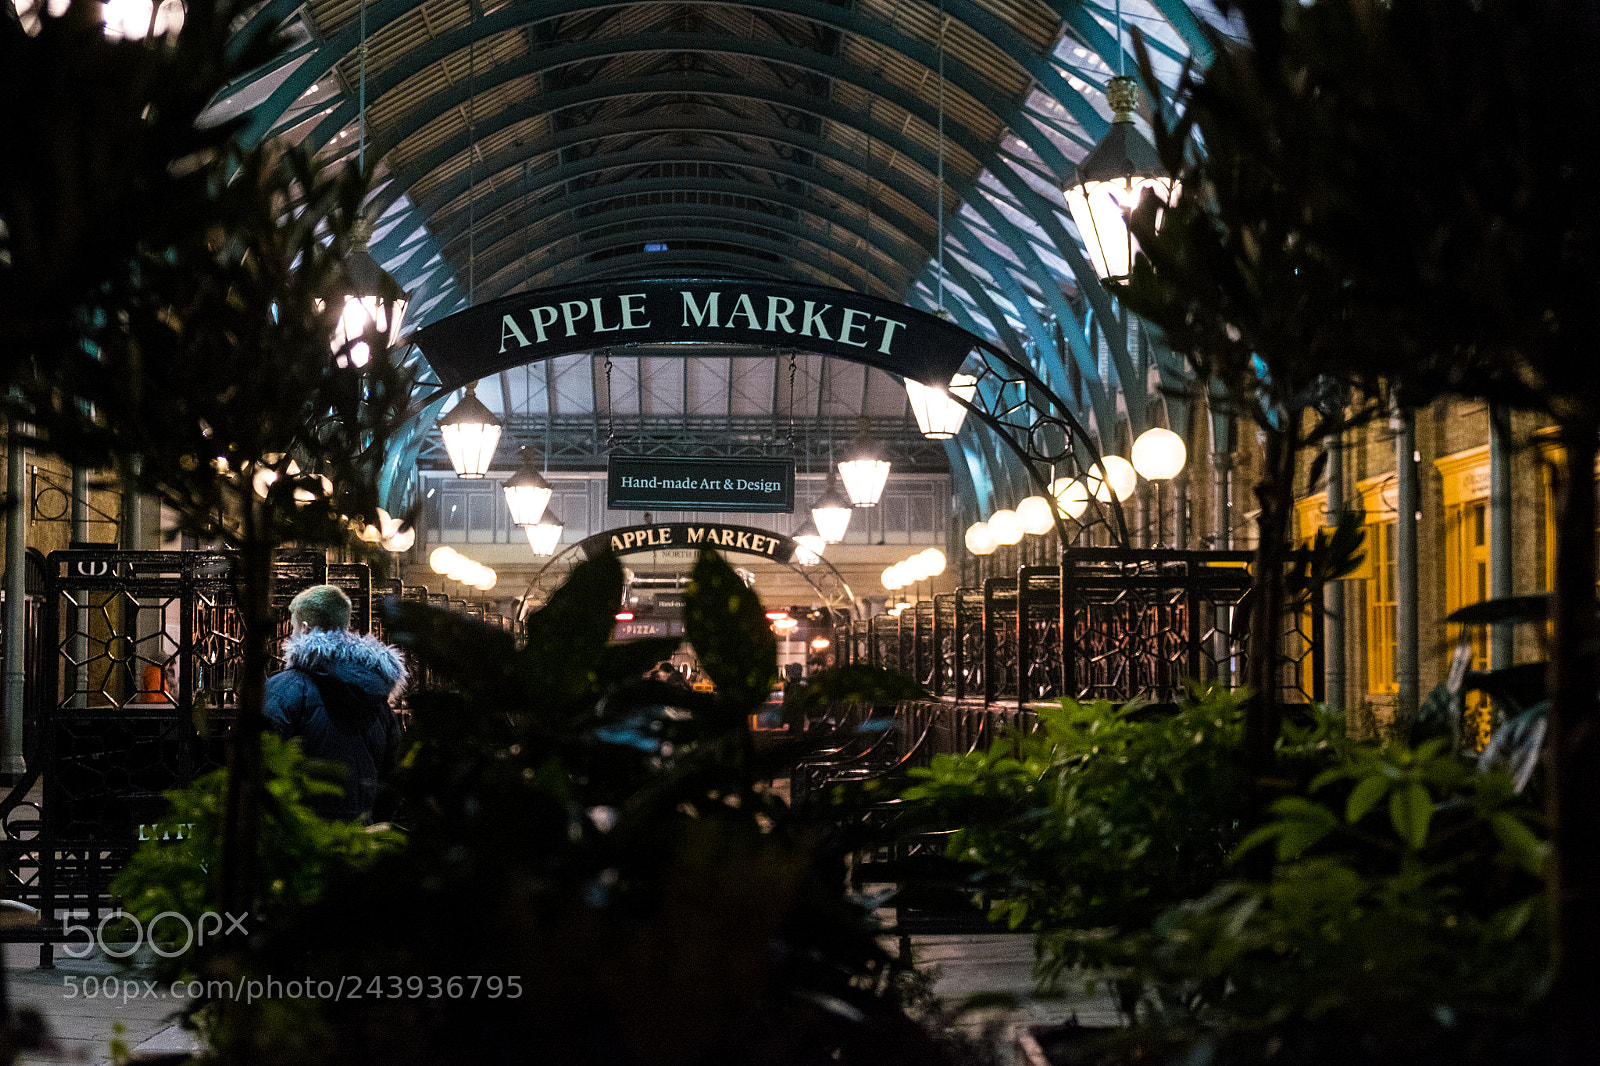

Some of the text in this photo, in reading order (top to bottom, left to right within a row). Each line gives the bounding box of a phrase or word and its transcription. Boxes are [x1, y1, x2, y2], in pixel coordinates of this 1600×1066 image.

[498, 291, 907, 355] APPLE MARKET
[620, 476, 782, 493] Hand-made Art & Design
[610, 527, 781, 555] APPLE MARKET
